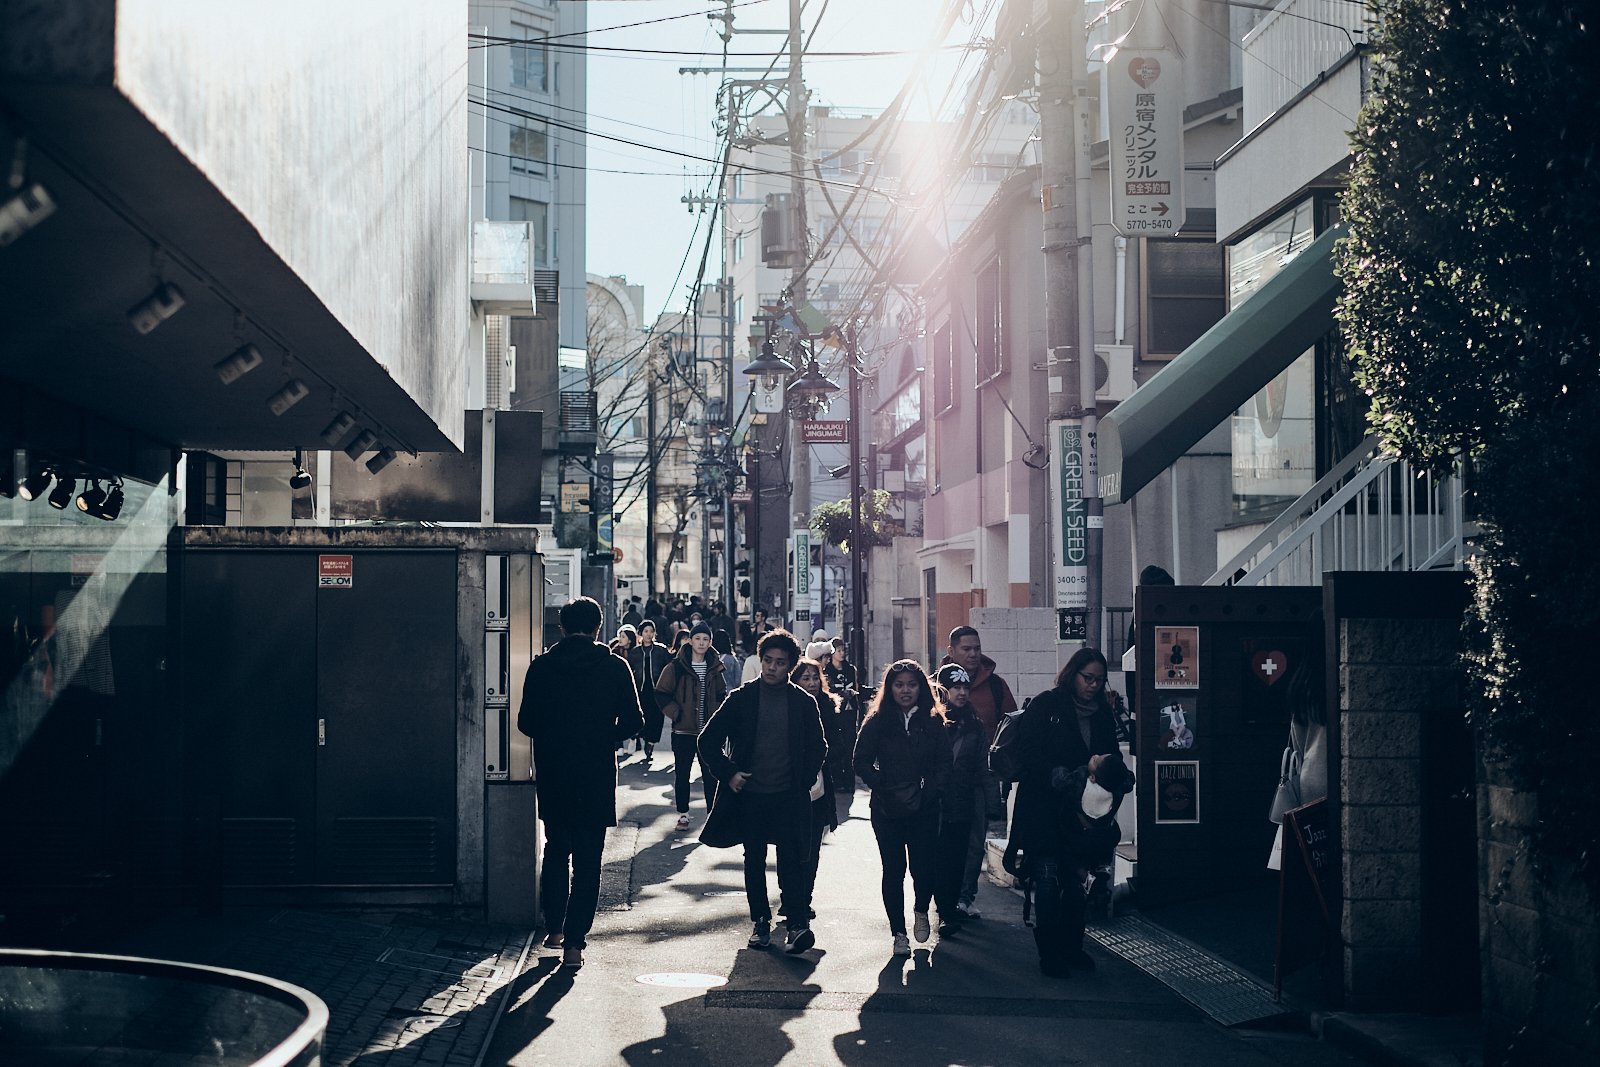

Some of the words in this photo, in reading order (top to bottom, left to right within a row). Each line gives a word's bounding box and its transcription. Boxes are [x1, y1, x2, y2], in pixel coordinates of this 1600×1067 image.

[1136, 93, 1157, 179] 原宿メンタル
[1125, 125, 1136, 179] クリニック
[1127, 204, 1147, 214] ここ
[1126, 219, 1172, 230] 5770-5470
[803, 423, 844, 431] HARAJUKU
[1065, 450, 1083, 512] GREEN
[1067, 515, 1085, 562] SEED
[798, 545, 807, 571] GREEN
[799, 572, 807, 593] SEED
[1057, 575, 1087, 584] 3400-5
[1160, 765, 1176, 780] JAZZ
[1177, 765, 1195, 779] UNION
[1303, 823, 1327, 845] Jazz
